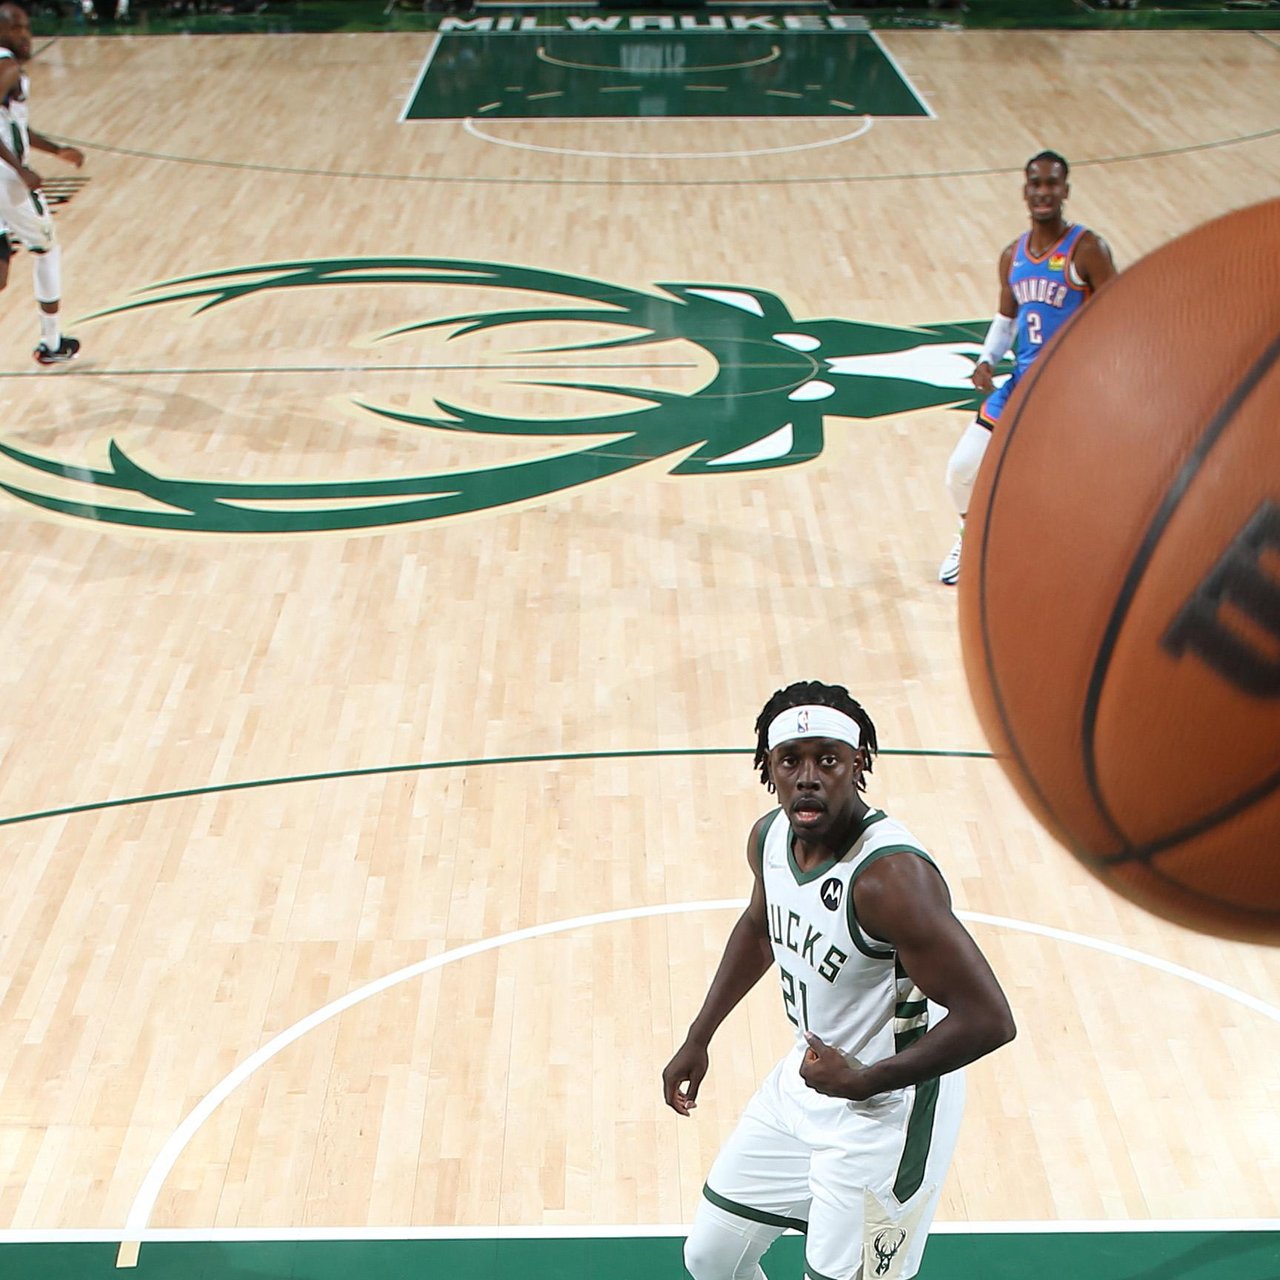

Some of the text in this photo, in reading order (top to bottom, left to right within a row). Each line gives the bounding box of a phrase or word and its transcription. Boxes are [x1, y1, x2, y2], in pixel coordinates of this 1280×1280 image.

[438, 15, 870, 31] MILWAUKEE
[1026, 311, 1043, 344] 2
[769, 902, 849, 985] UCKS
[780, 965, 810, 1031] 21
